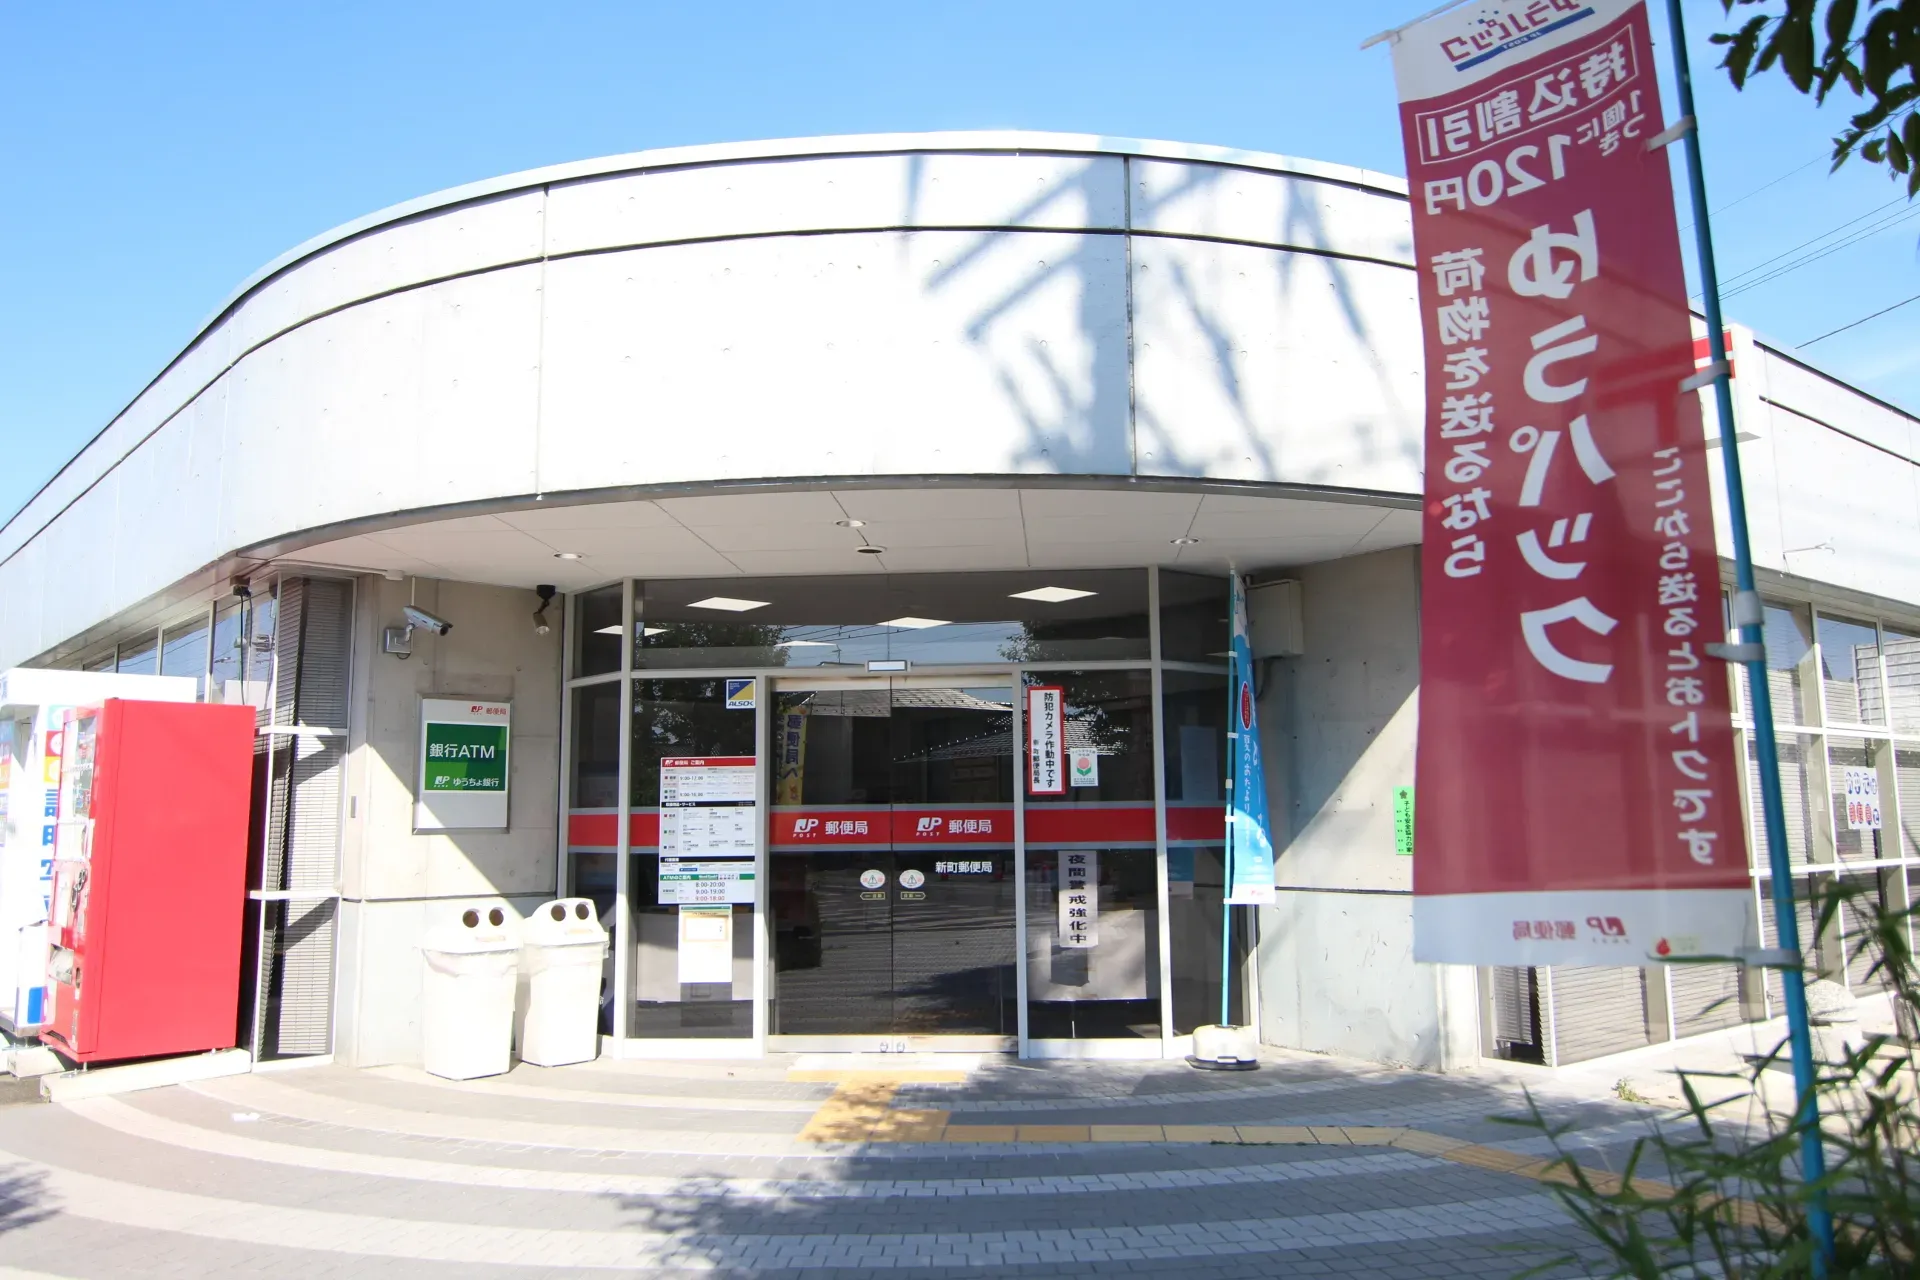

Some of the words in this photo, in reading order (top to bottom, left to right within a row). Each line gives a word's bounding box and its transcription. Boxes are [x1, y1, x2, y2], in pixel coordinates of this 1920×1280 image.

[486, 707, 507, 715] 郵便局
[1044, 692, 1055, 788] 防犯カメラ作動中です
[429, 743, 495, 759] 銀行ATM
[453, 777, 500, 787] ゆうちょ銀行
[794, 818, 819, 833] JP
[825, 821, 868, 835] 郵便局
[917, 817, 943, 832] JP
[948, 819, 992, 834] 郵便局
[935, 861, 993, 873] 新町郵便局
[1068, 854, 1087, 944] 夜間警戒強化中
